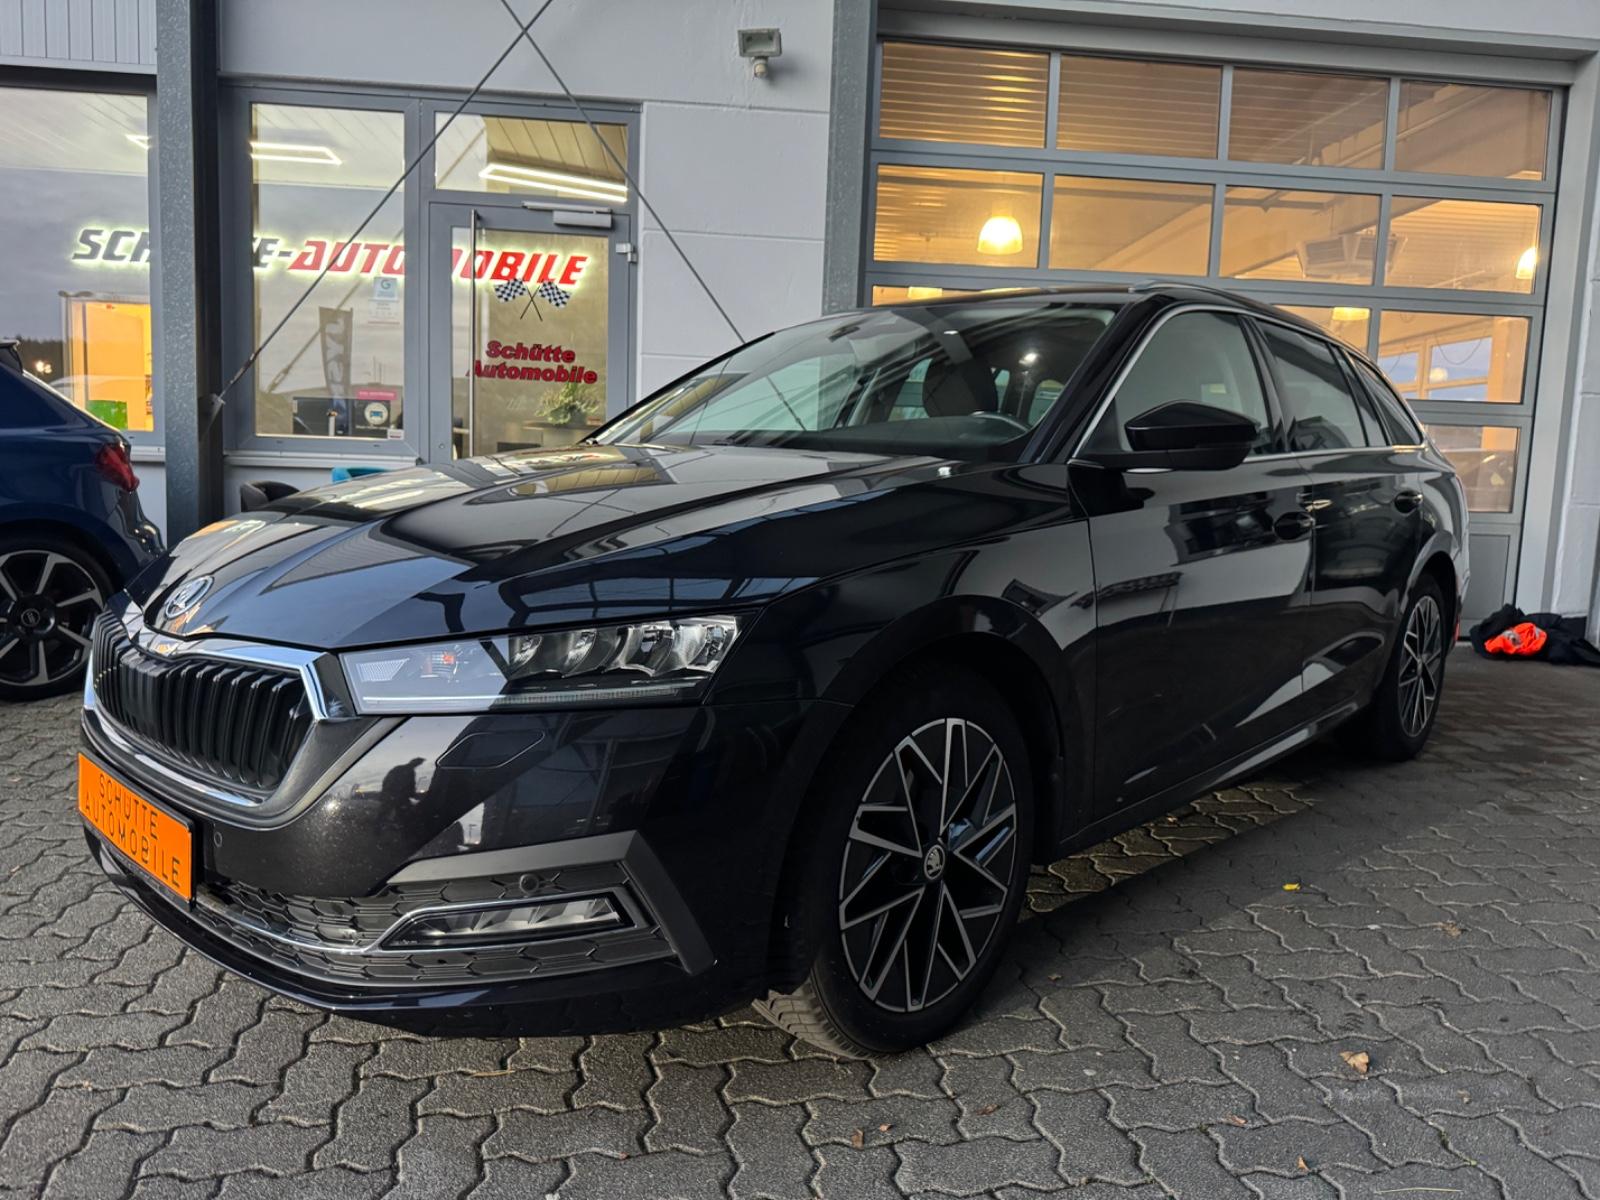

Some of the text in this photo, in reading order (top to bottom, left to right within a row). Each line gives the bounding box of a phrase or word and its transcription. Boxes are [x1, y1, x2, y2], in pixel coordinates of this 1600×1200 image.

[485, 340, 576, 363] Schütte
[465, 359, 598, 384] Automobile
[85, 791, 181, 888] AUTOMOBILE
